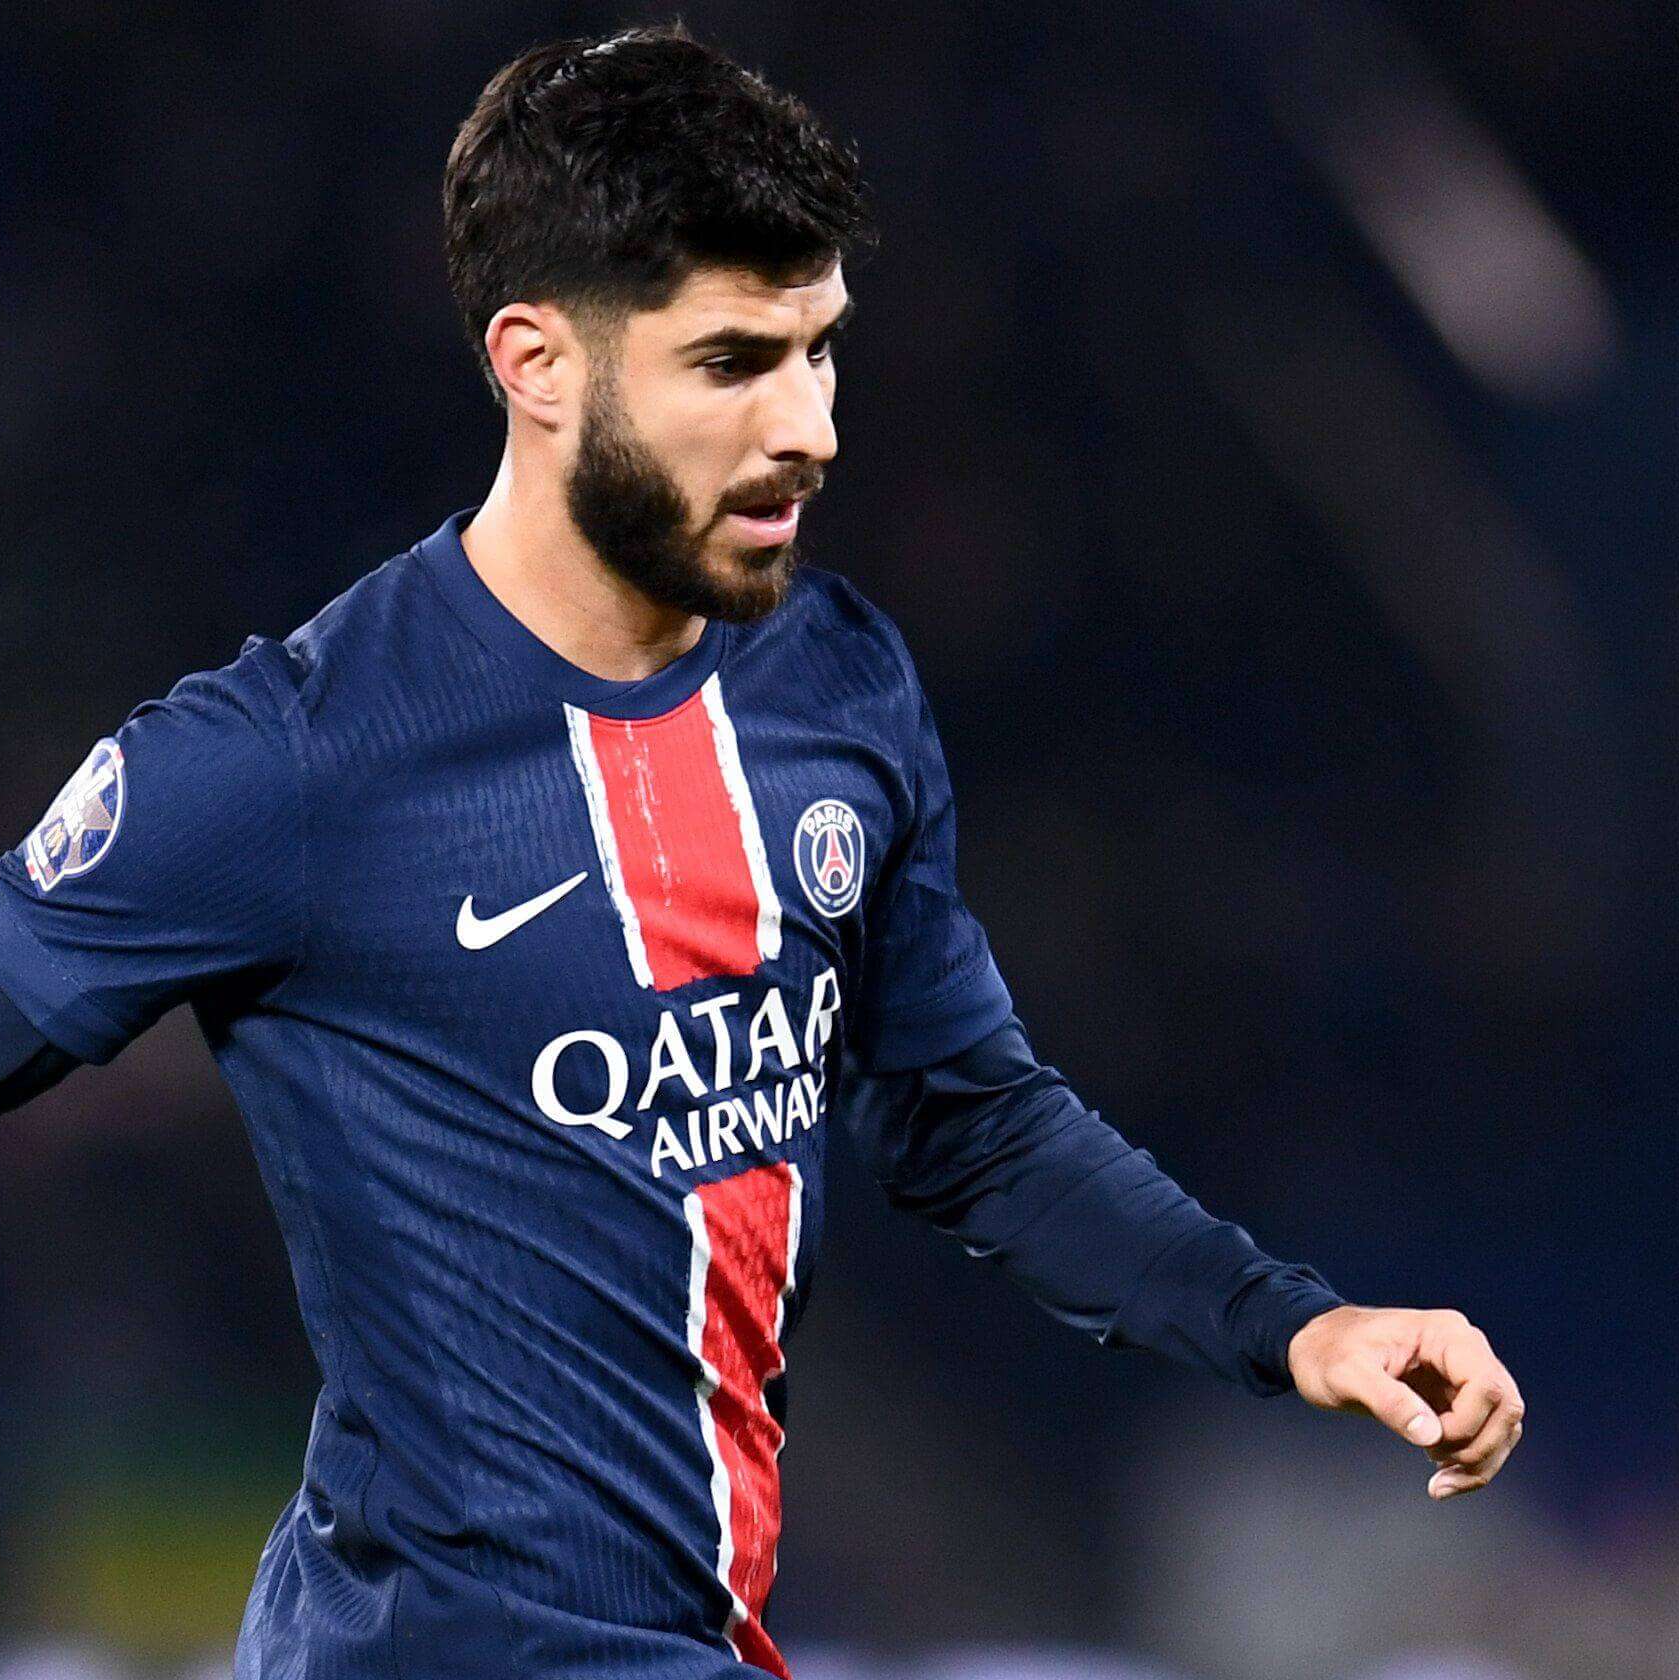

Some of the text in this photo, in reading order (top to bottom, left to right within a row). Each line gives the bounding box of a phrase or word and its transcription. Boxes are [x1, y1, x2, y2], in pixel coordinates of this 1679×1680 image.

[803, 805, 853, 837] PARIS
[531, 966, 841, 1140] QATAR
[650, 1055, 826, 1178] AIRWAY
